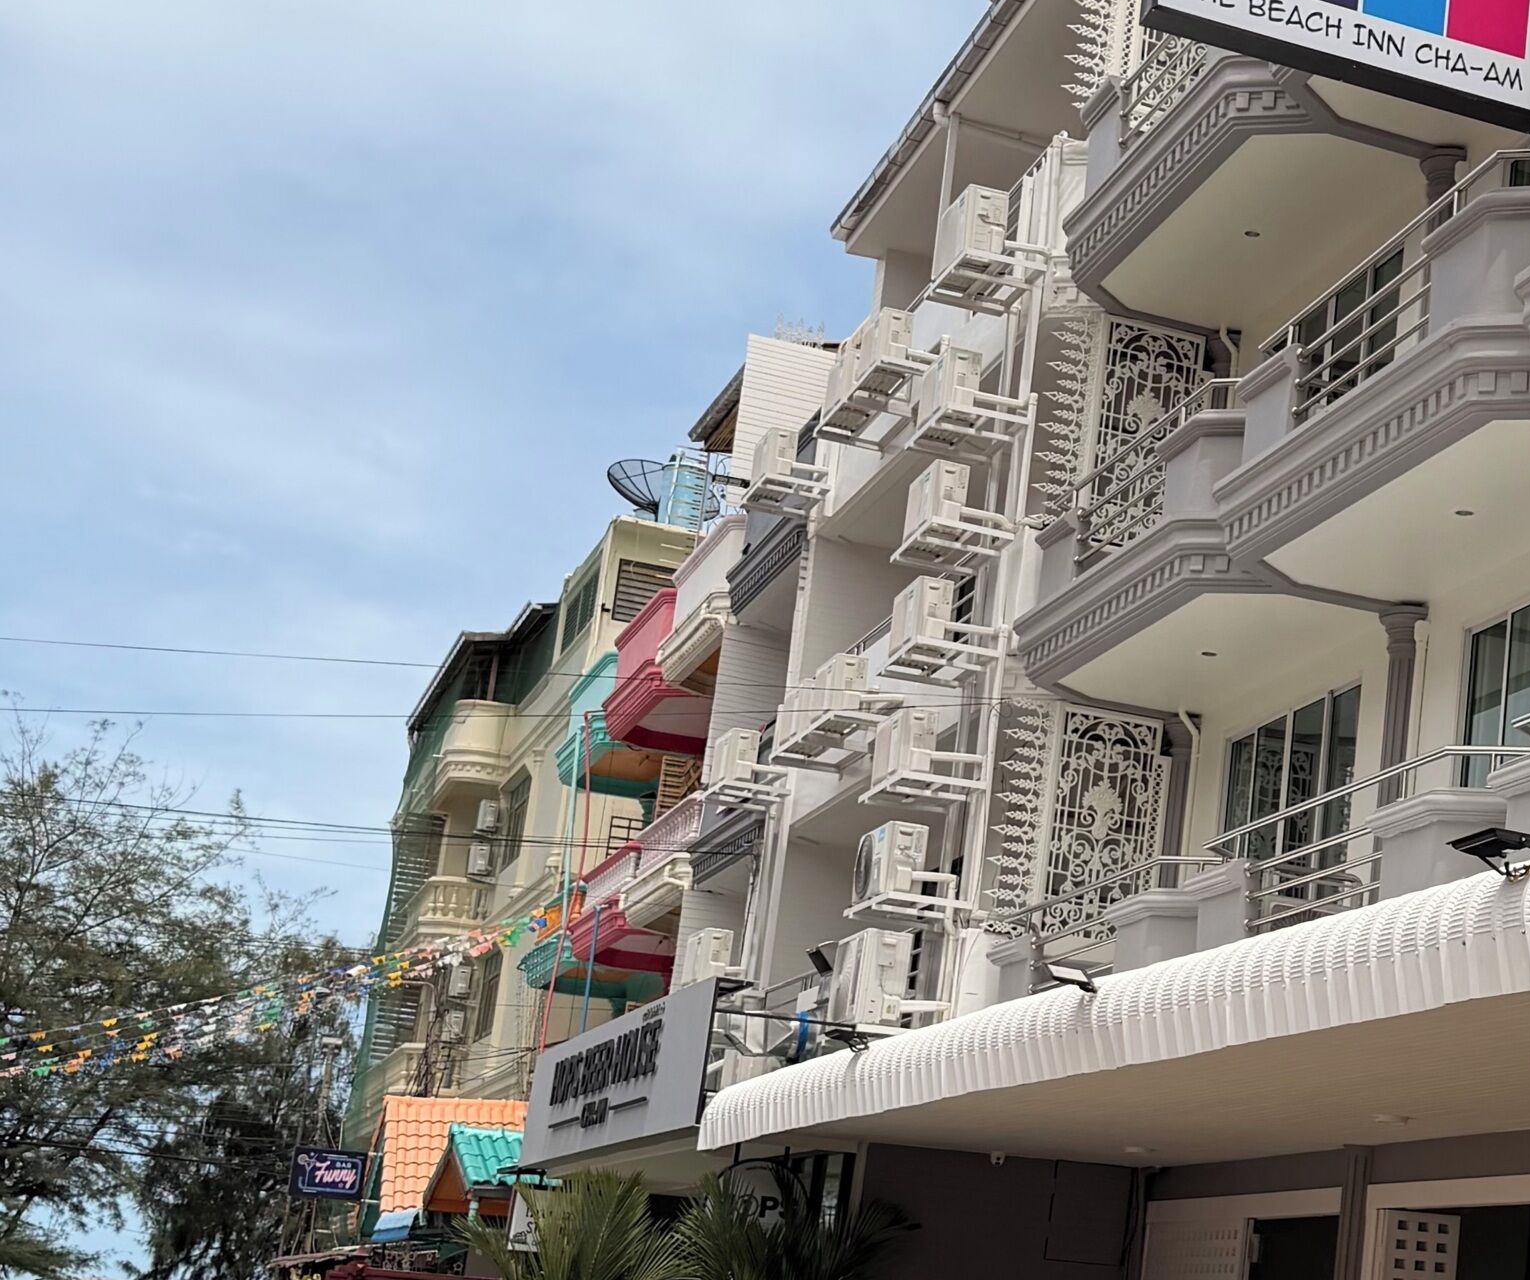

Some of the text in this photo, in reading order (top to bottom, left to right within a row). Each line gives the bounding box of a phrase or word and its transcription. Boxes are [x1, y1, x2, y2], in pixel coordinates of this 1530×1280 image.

[1352, 22, 1405, 58] INN
[1414, 43, 1524, 91] CHA-AM
[578, 1038, 616, 1095] BEER
[610, 1018, 663, 1084] HOUSE
[314, 1160, 357, 1189] Funny
